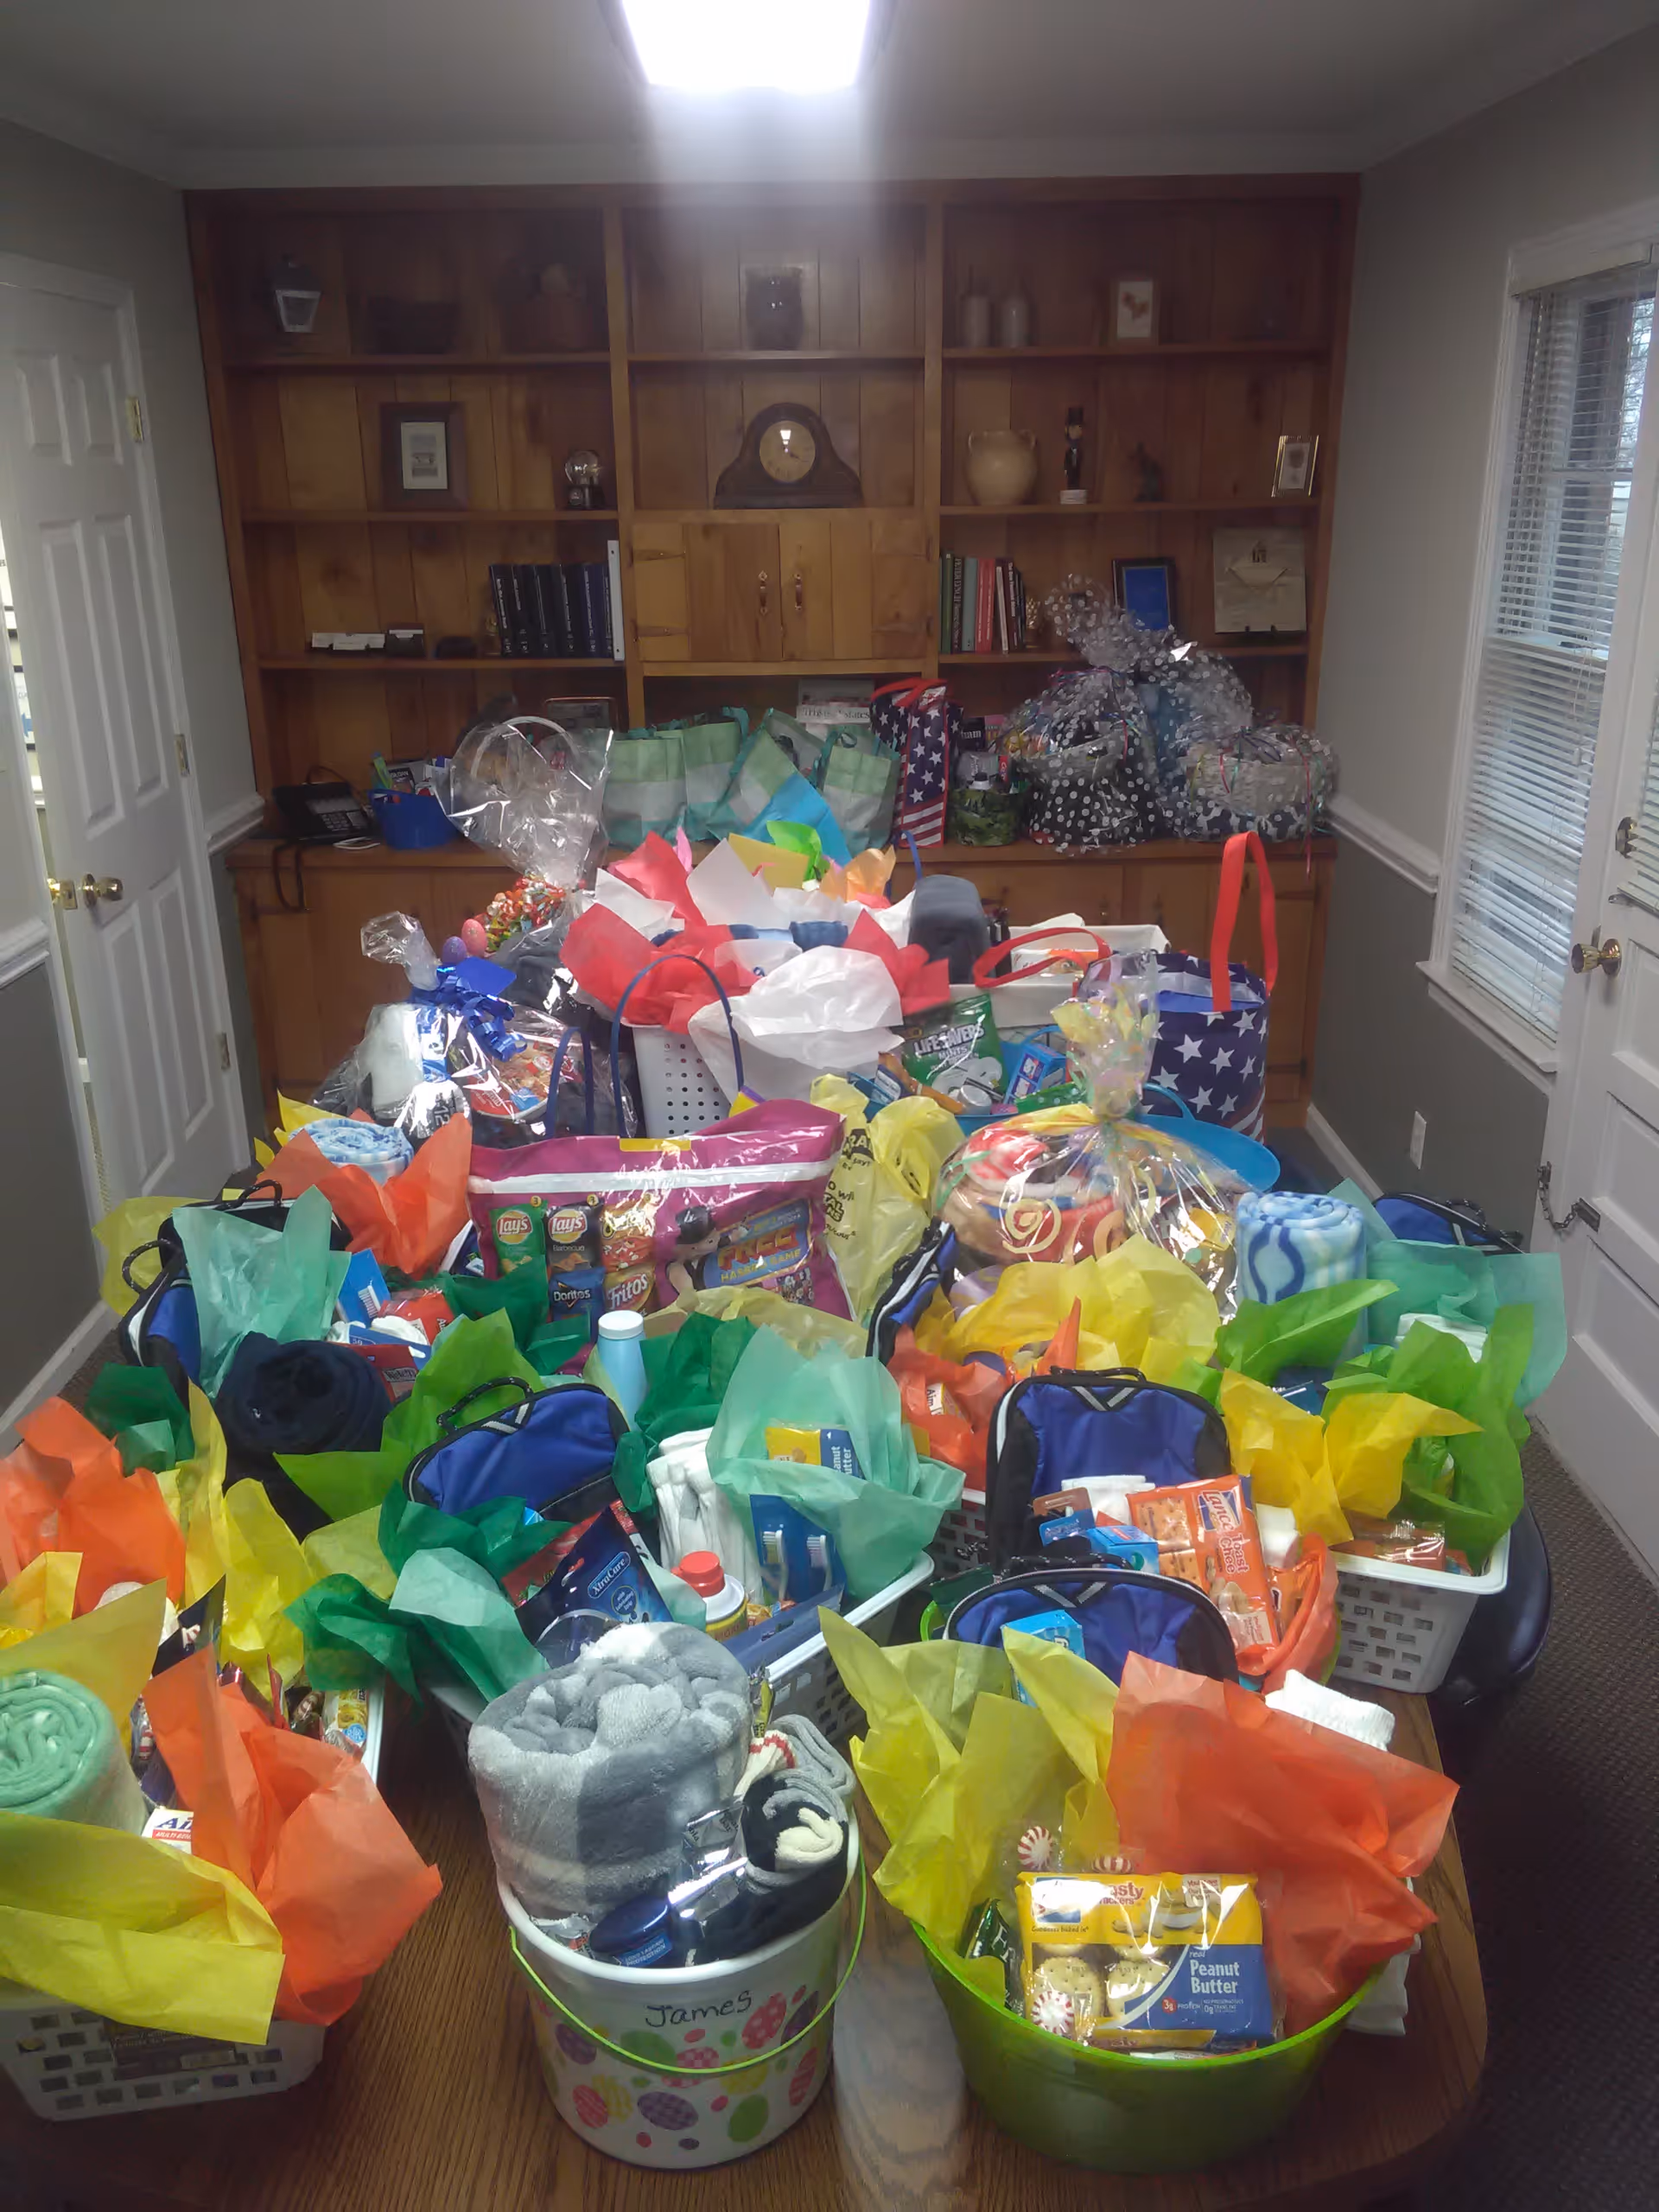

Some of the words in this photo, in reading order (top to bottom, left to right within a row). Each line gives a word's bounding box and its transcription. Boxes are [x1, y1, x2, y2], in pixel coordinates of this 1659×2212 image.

[938, 1023, 985, 1049] SAVERS
[938, 1046, 969, 1060] MINTS
[499, 1216, 531, 1236] Lay's
[551, 1216, 584, 1235] Lay's
[553, 1287, 591, 1302] Doritos
[608, 1273, 648, 1310] Fritos
[1202, 1491, 1234, 1533] Lance
[1219, 1536, 1236, 1573] Chee
[1231, 1533, 1250, 1573] Toast
[592, 1559, 626, 1595] XtraCare
[1189, 1959, 1241, 1977] Peanut
[1191, 1976, 1238, 1994] Butter
[645, 1989, 753, 2028] James
